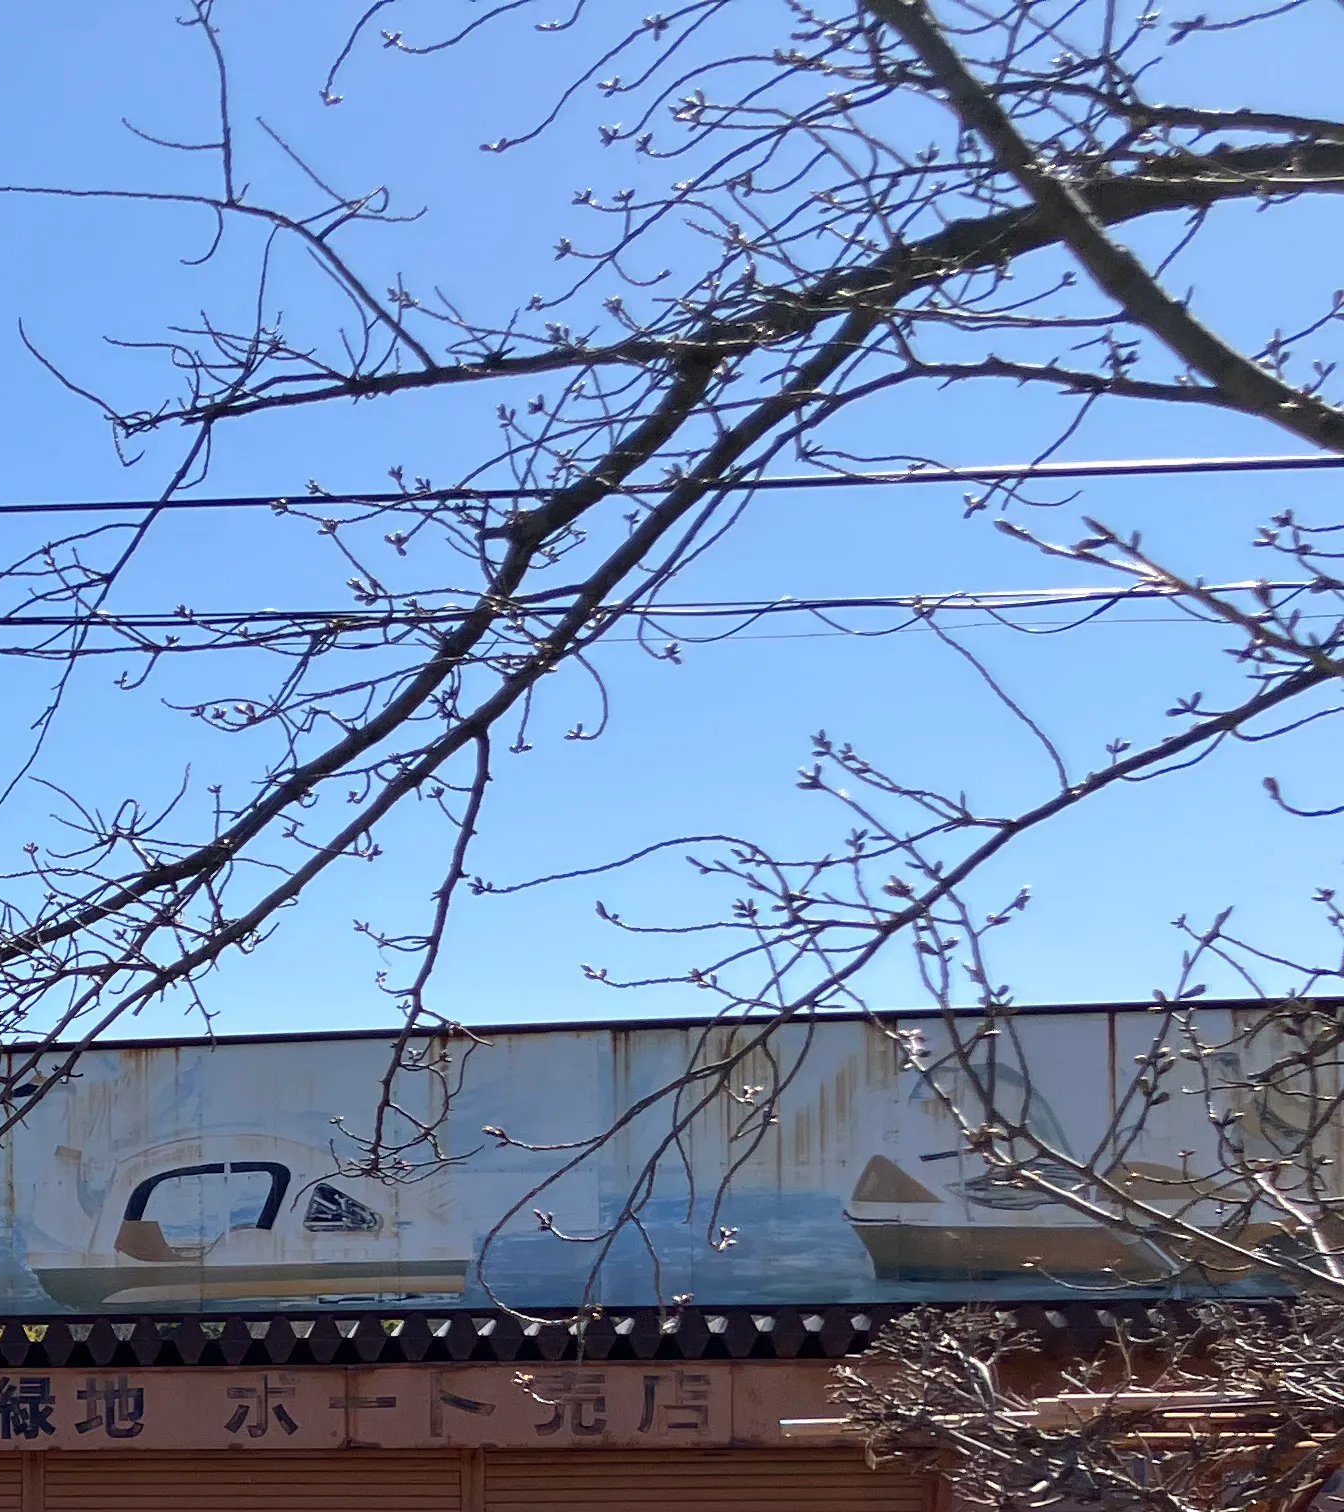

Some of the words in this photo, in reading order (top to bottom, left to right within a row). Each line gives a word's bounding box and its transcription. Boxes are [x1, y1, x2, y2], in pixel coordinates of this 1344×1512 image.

[224, 1373, 708, 1438] ボート売店
